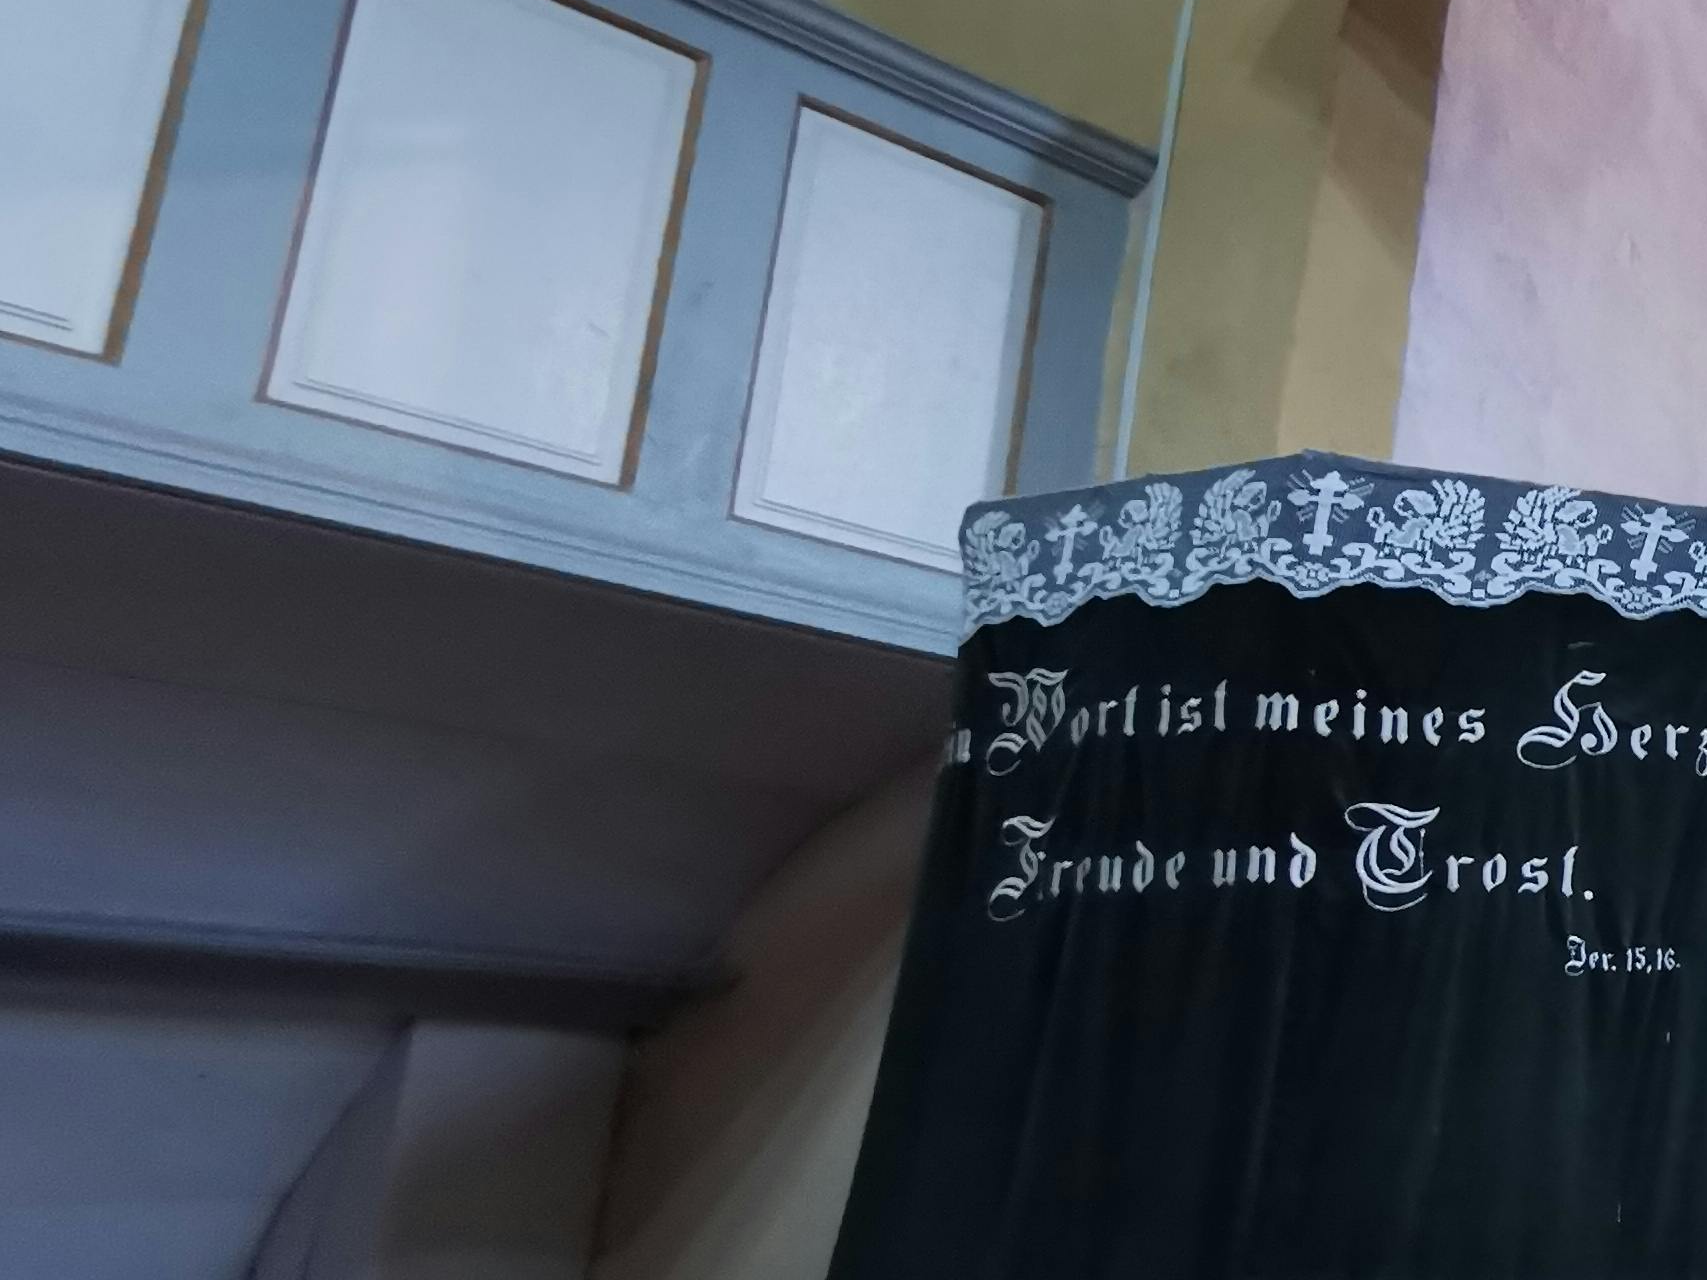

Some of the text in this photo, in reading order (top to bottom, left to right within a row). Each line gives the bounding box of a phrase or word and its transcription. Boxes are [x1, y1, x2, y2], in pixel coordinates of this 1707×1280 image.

[985, 667, 1139, 777] Wort
[1157, 678, 1229, 739] ist
[1254, 686, 1487, 748] meines
[987, 802, 1595, 922] Freude und Trost.
[1564, 934, 1617, 976] Jer.
